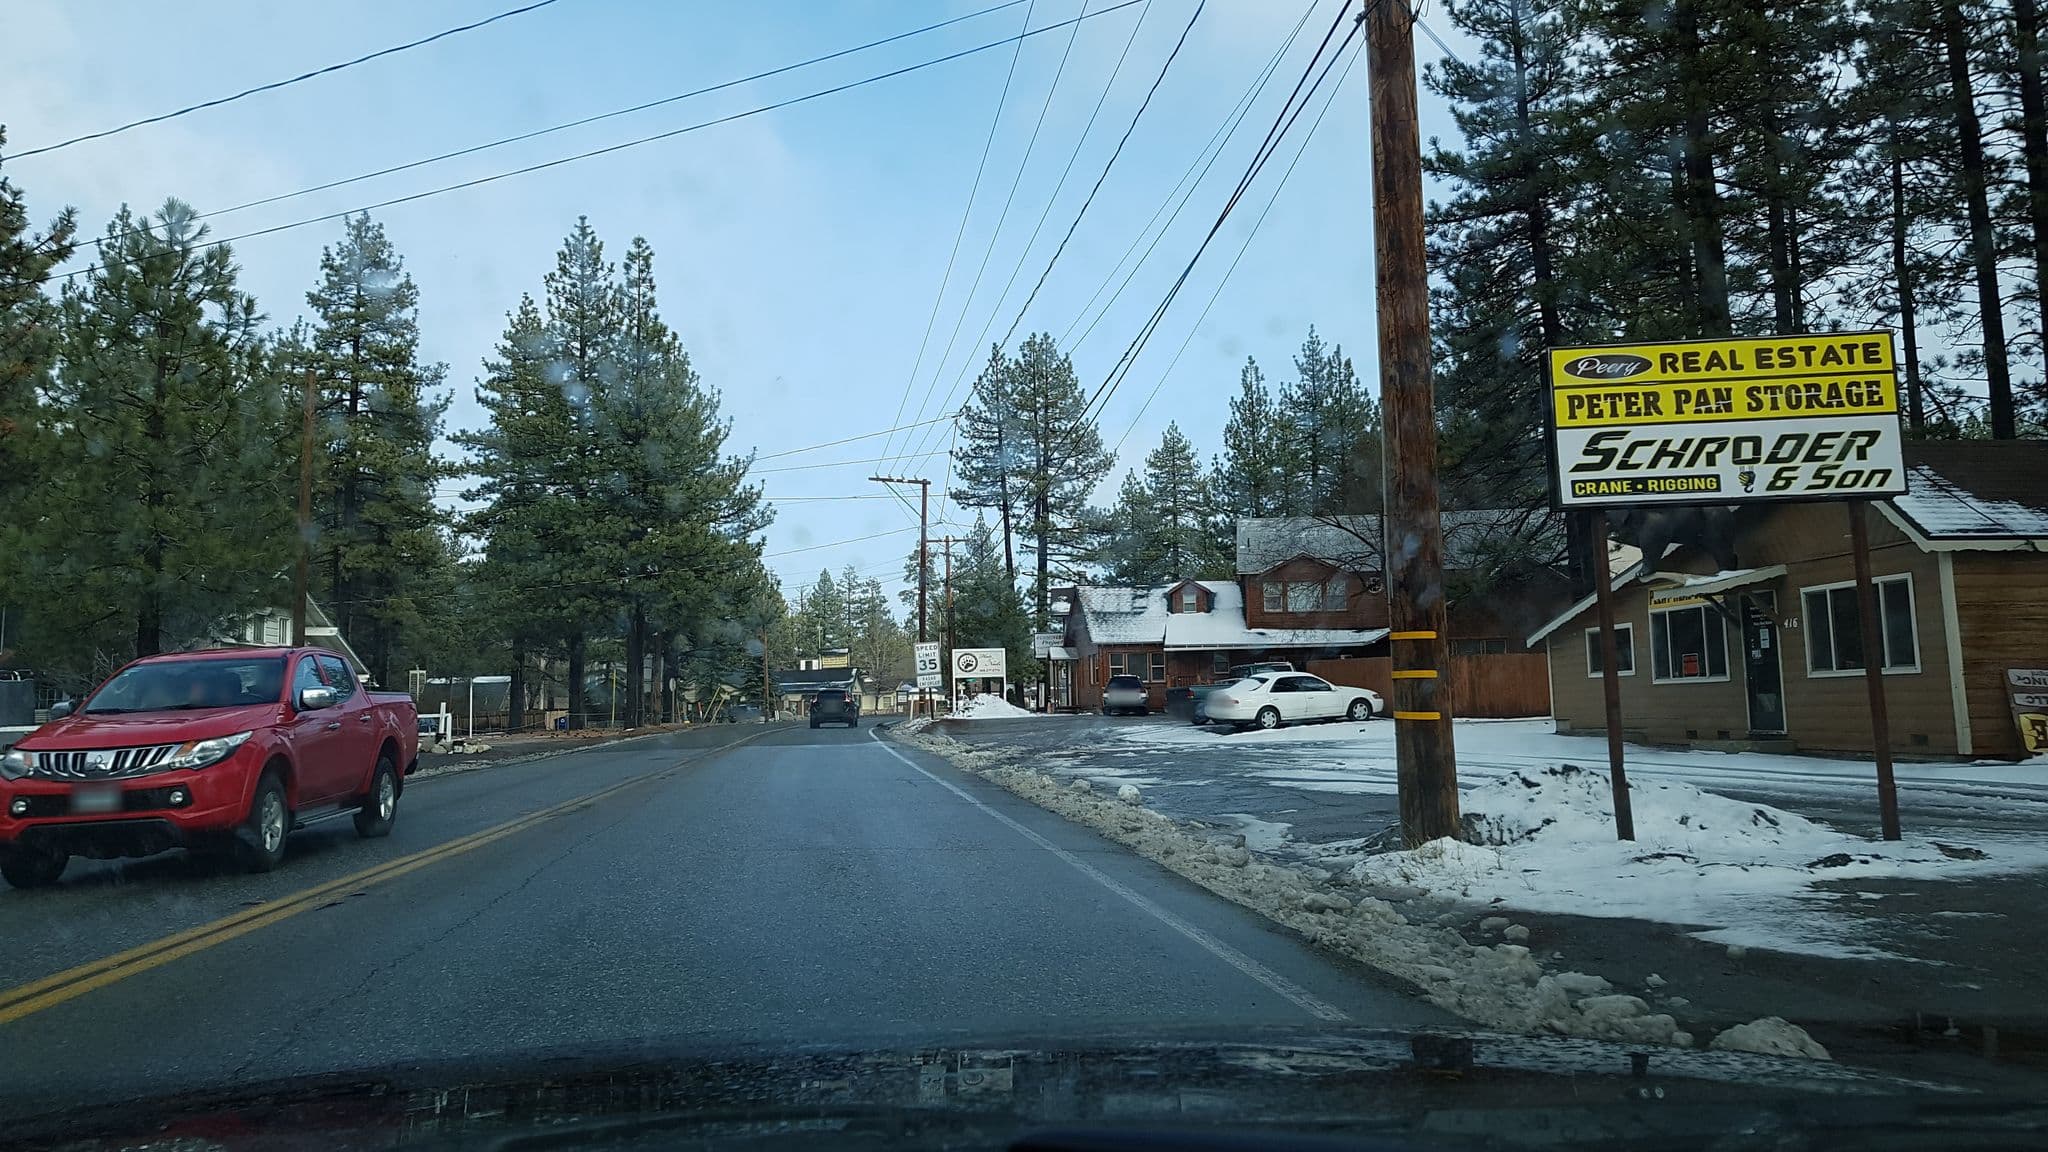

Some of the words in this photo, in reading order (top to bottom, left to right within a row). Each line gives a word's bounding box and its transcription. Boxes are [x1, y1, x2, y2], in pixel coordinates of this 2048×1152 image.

[1576, 357, 1641, 376] Peery
[1659, 350, 1745, 374] REAL
[1755, 342, 1883, 370] ESTATE
[1567, 389, 1664, 420] PETER
[1674, 386, 1734, 416] PAN
[1746, 380, 1885, 413] STORAGE
[1575, 480, 1633, 495] CRANE
[1648, 477, 1718, 491] RIGGING
[1765, 466, 1798, 492] &
[919, 659, 937, 671] 35
